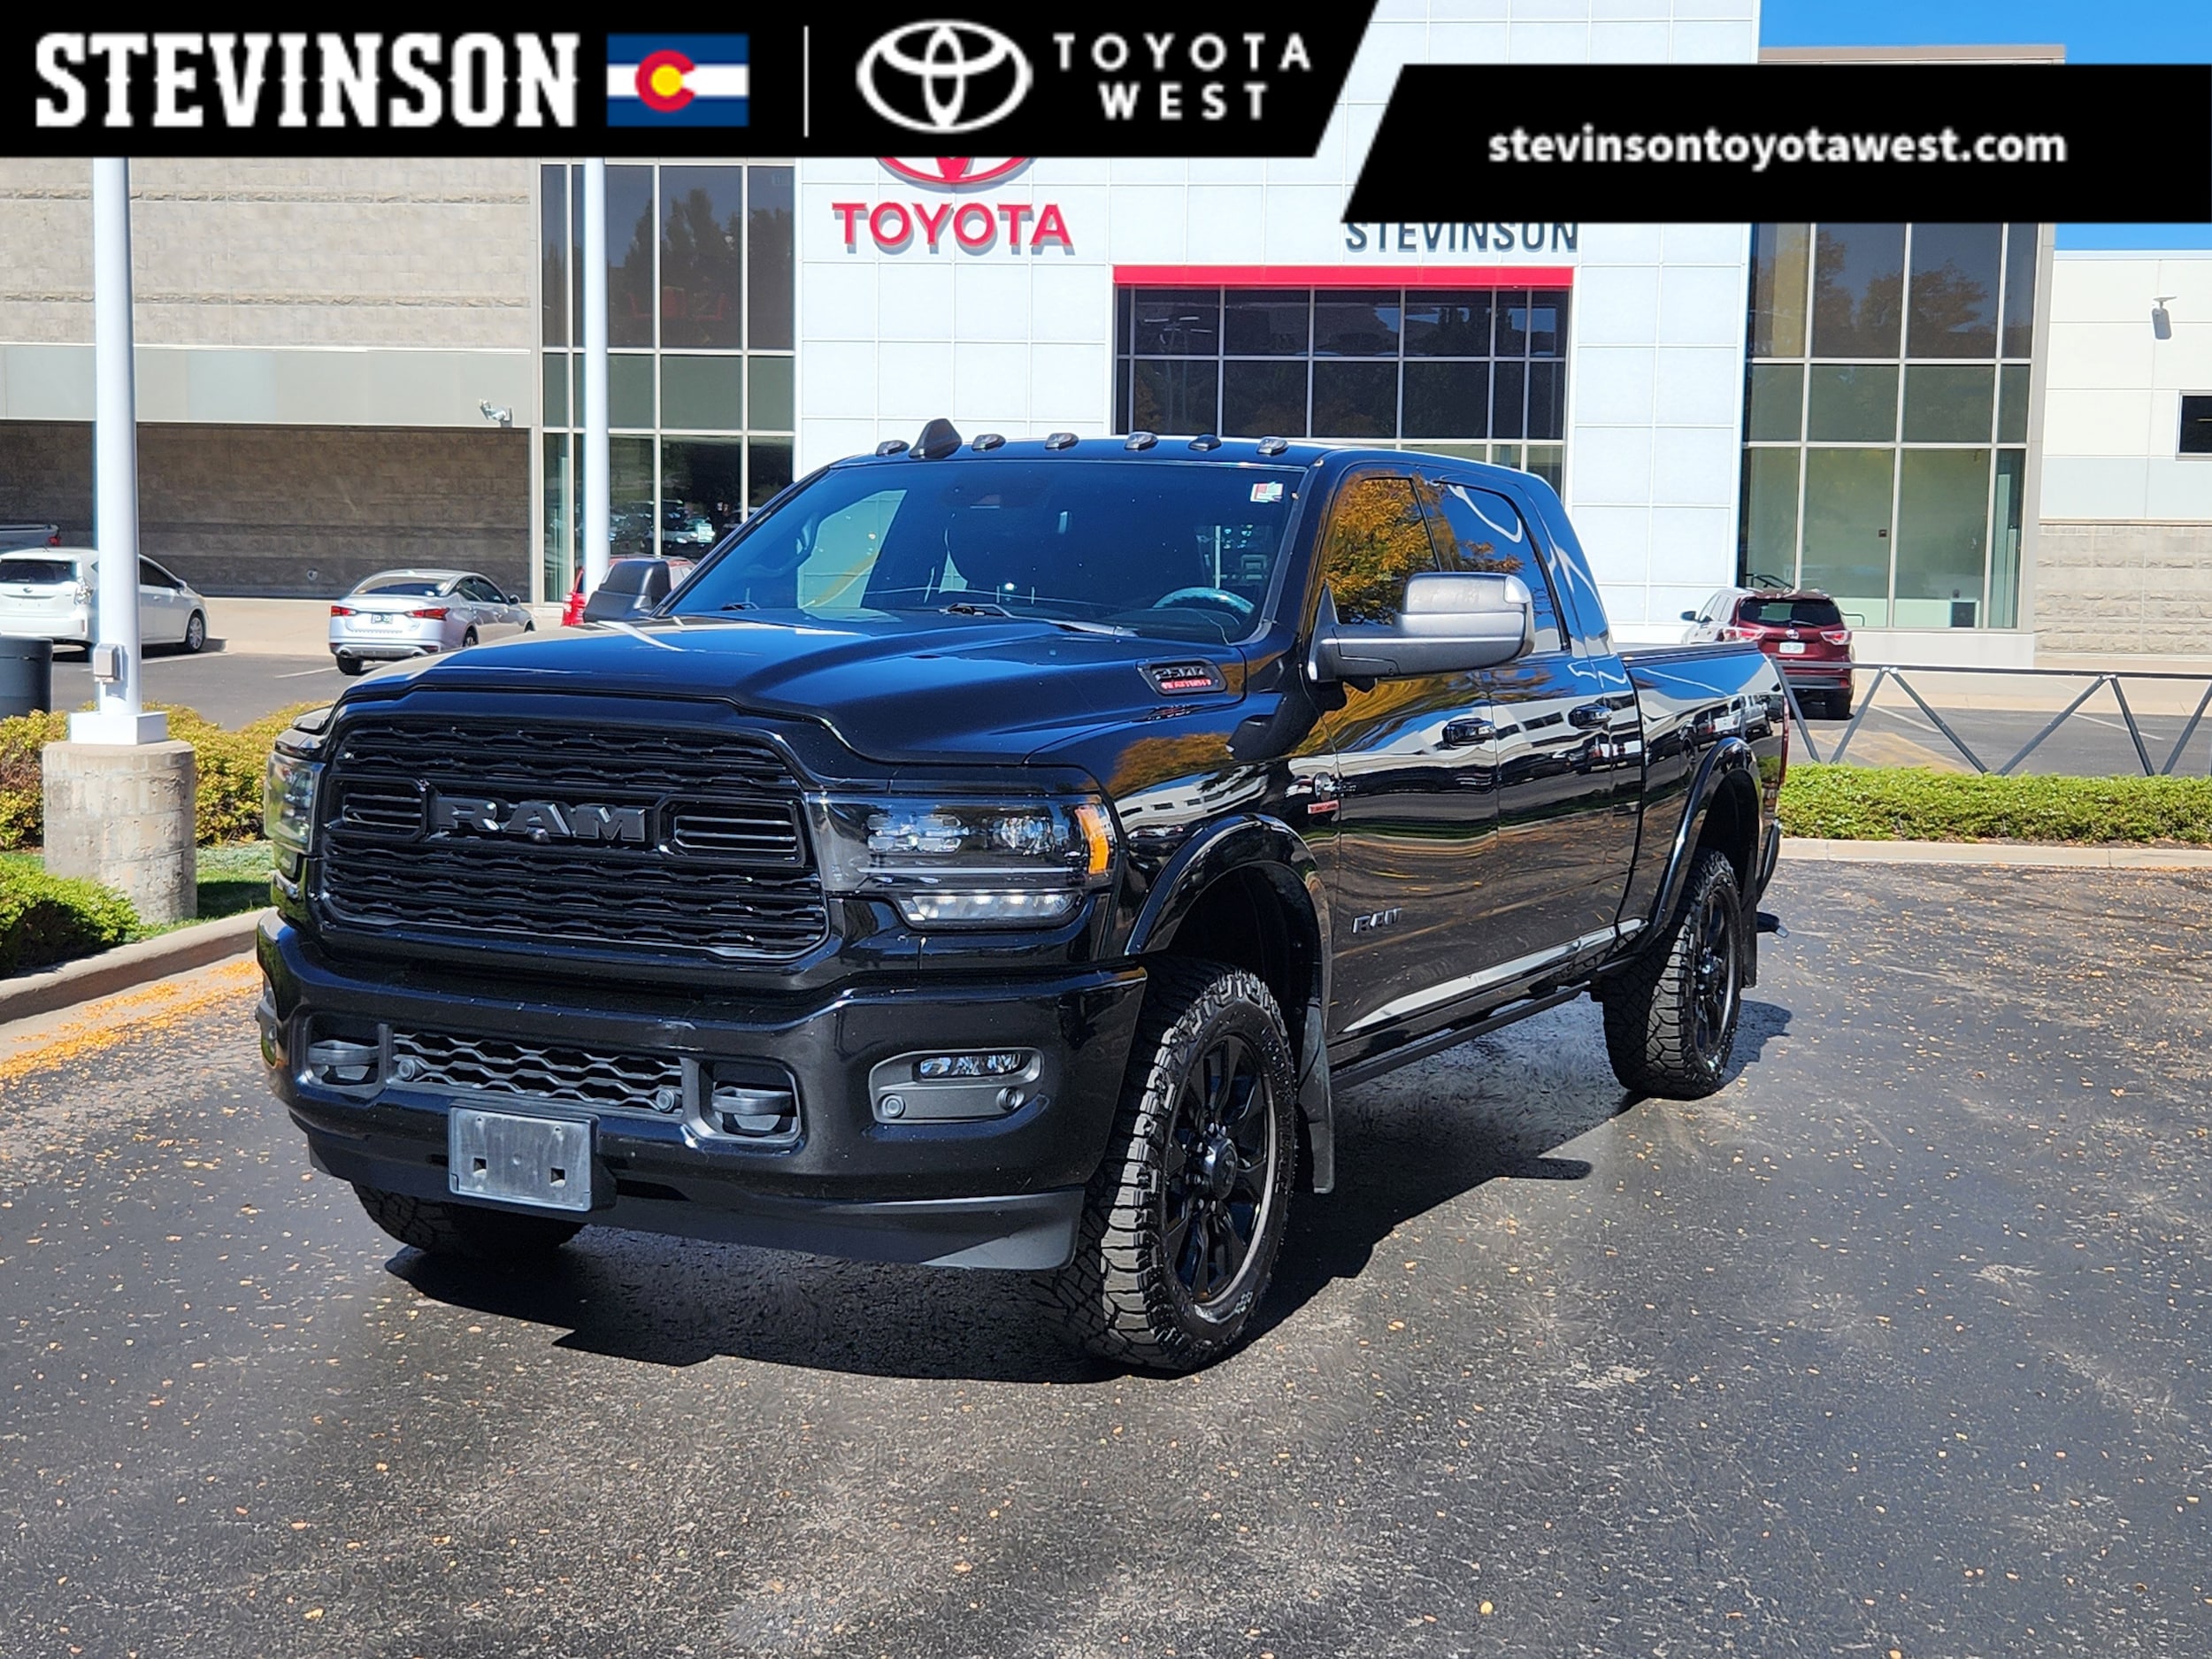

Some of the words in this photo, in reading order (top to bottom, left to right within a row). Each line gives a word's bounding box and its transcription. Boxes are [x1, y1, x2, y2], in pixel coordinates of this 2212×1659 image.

[832, 202, 1074, 254] TOYOTA
[1345, 222, 1578, 251] STEVINSON
[435, 795, 646, 841] RAM
